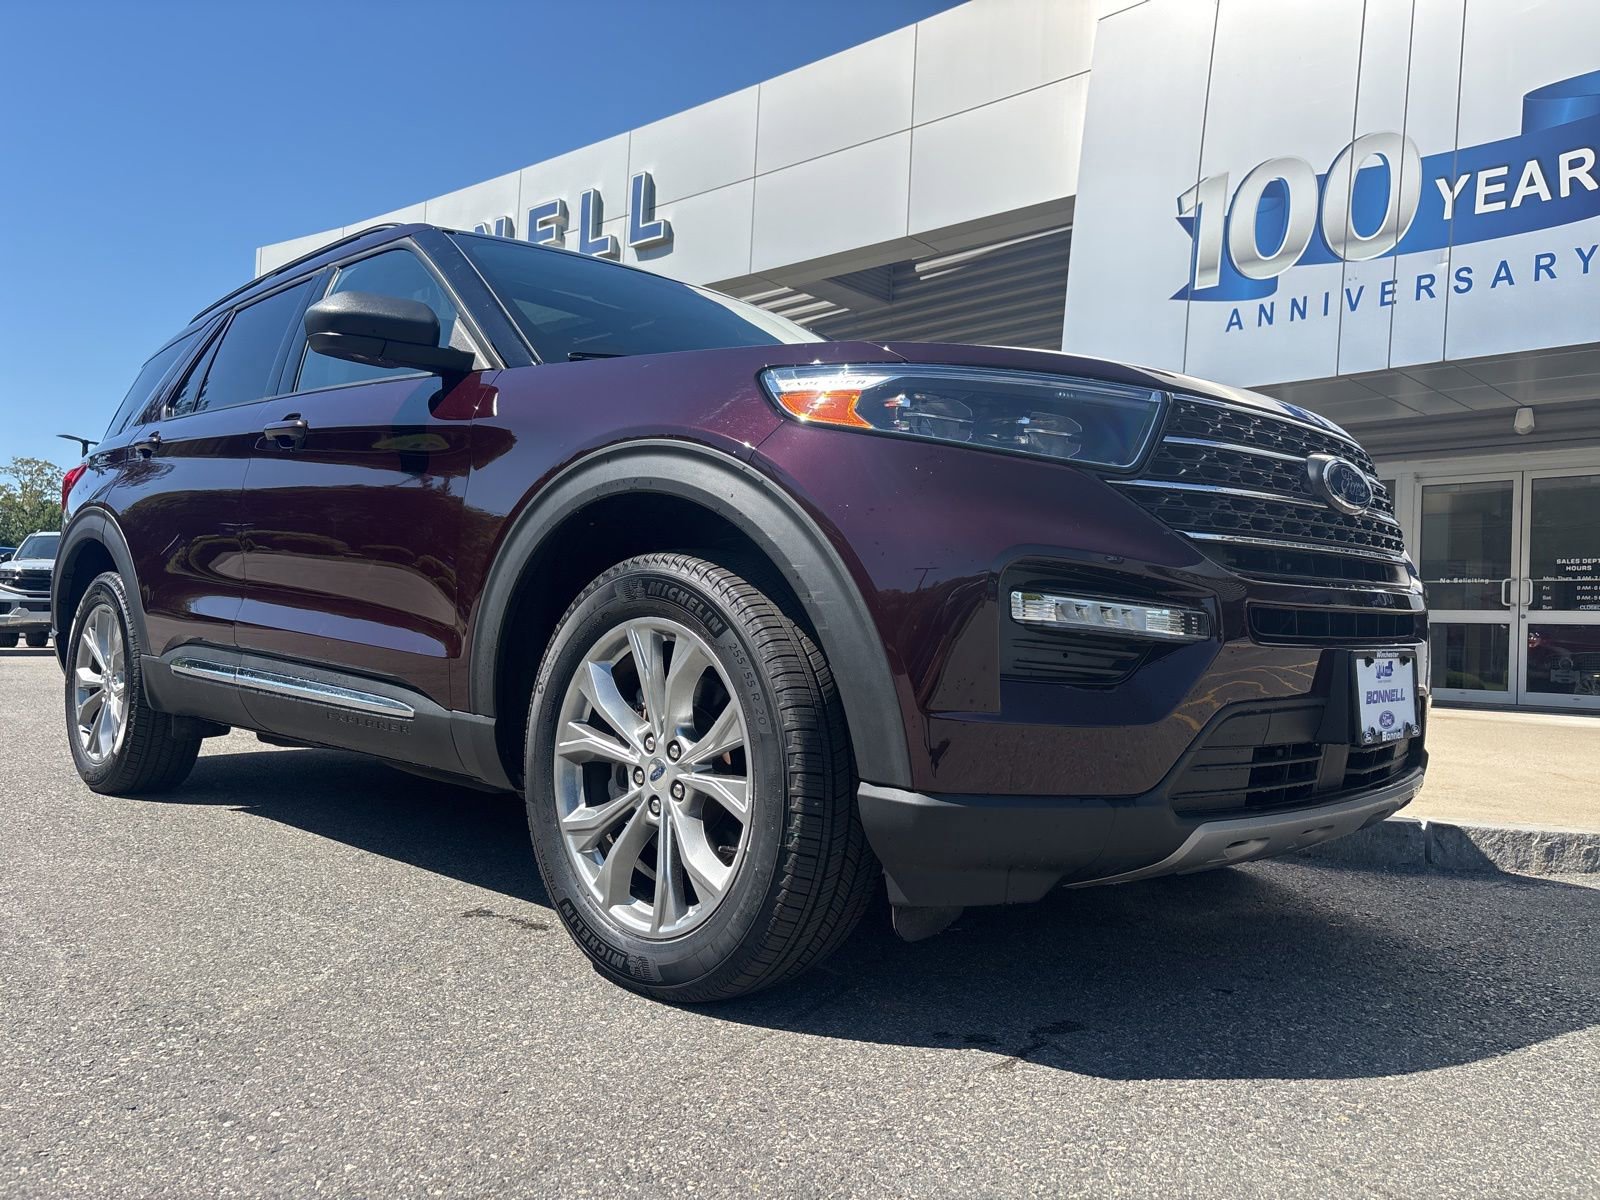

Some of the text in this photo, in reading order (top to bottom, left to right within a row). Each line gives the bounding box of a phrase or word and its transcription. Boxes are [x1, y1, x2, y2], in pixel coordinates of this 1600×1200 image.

[1176, 132, 1422, 291] 100
[1225, 244, 1599, 333] ANNIVERSARY
[647, 581, 726, 634] MICHELIN
[1453, 577, 1489, 585] Soliciting
[1365, 688, 1405, 705] BONNELL
[559, 900, 626, 970] MICHELIN
